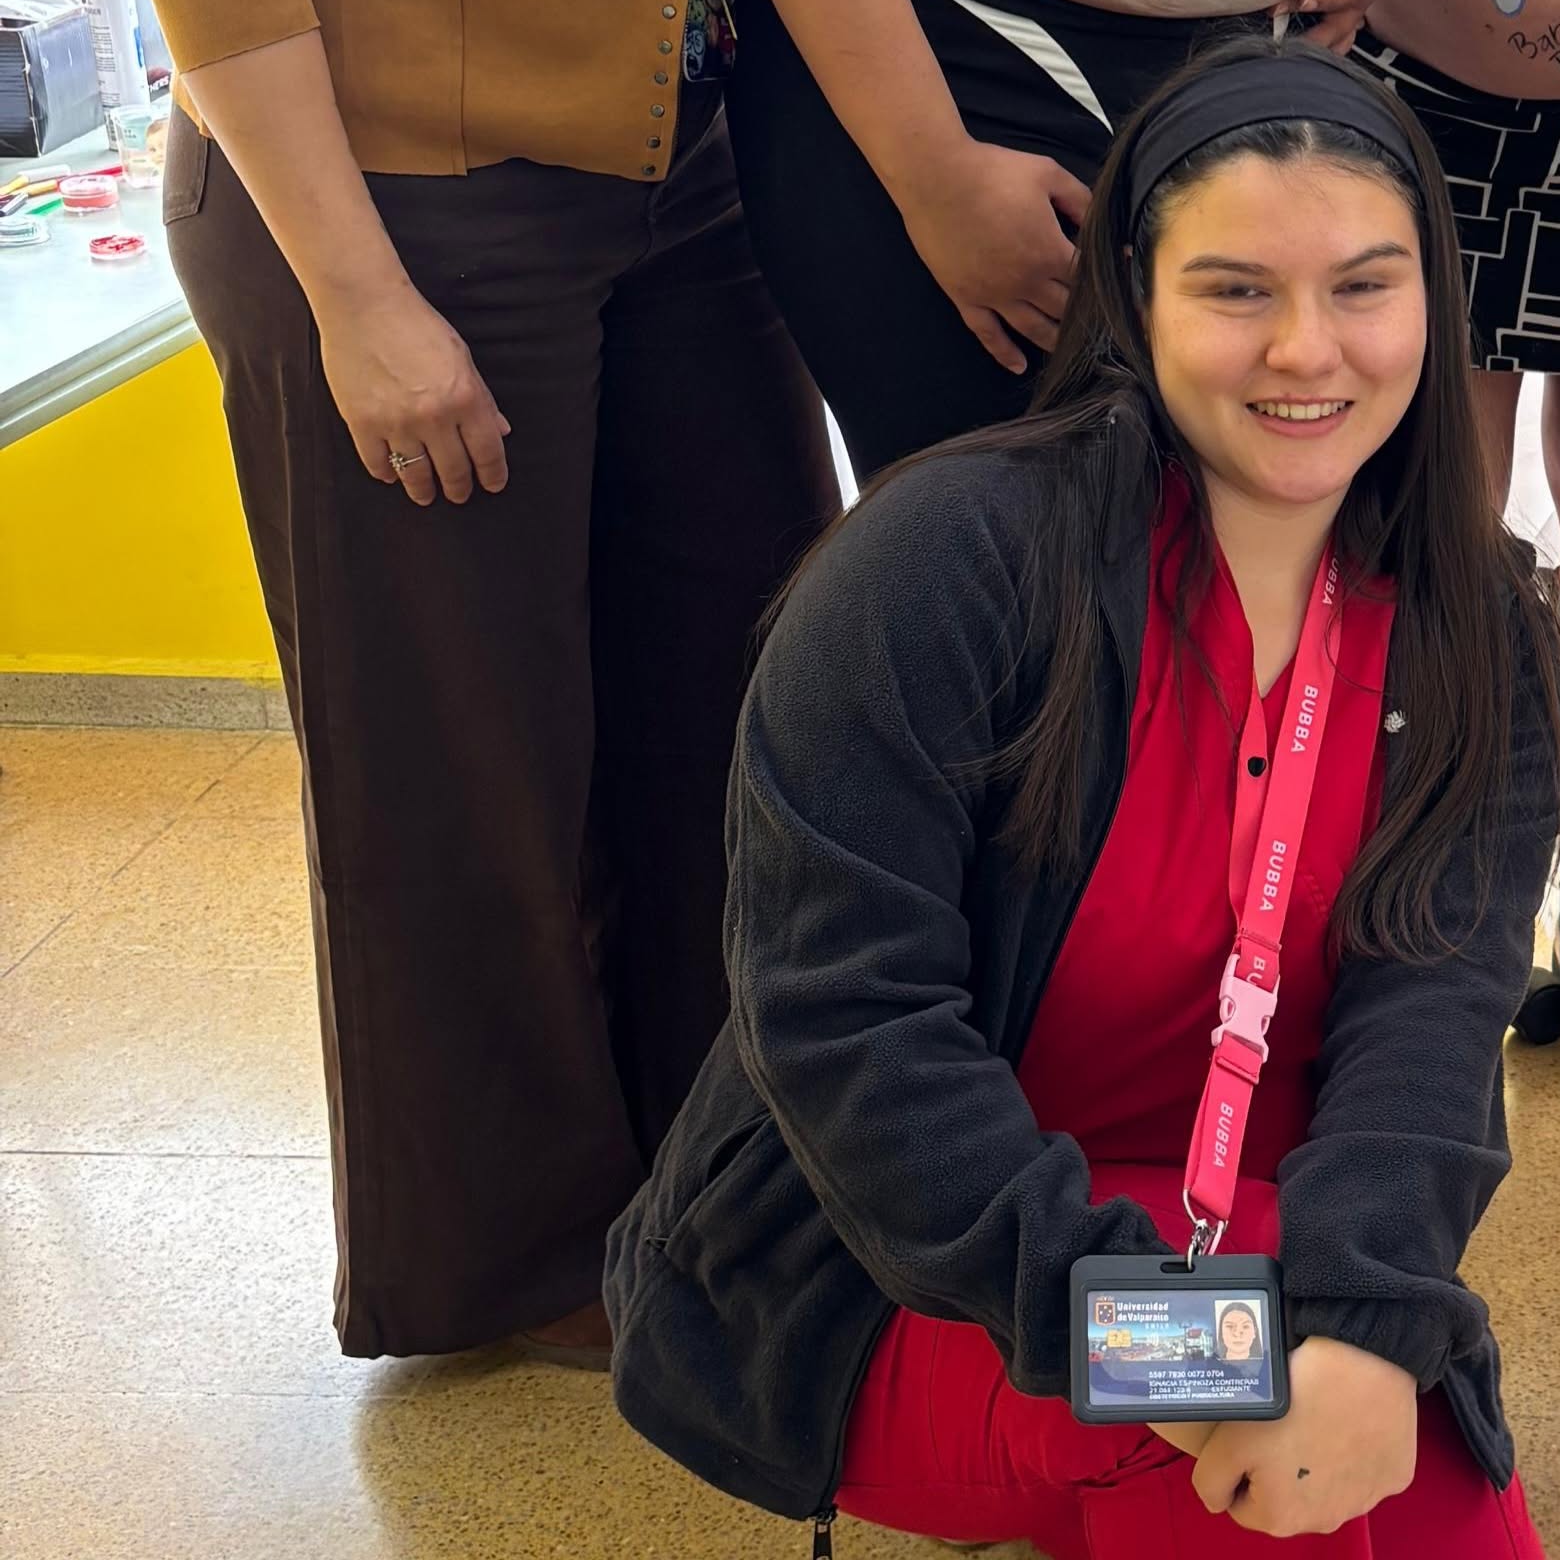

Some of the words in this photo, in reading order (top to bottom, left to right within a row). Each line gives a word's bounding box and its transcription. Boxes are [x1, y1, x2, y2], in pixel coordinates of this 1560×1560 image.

[1321, 556, 1340, 605] UBBA
[1290, 684, 1320, 754] BUBBA
[1259, 839, 1288, 912] BUBBA
[1211, 1101, 1235, 1169] BUBBA
[1116, 1301, 1169, 1311] Universidad
